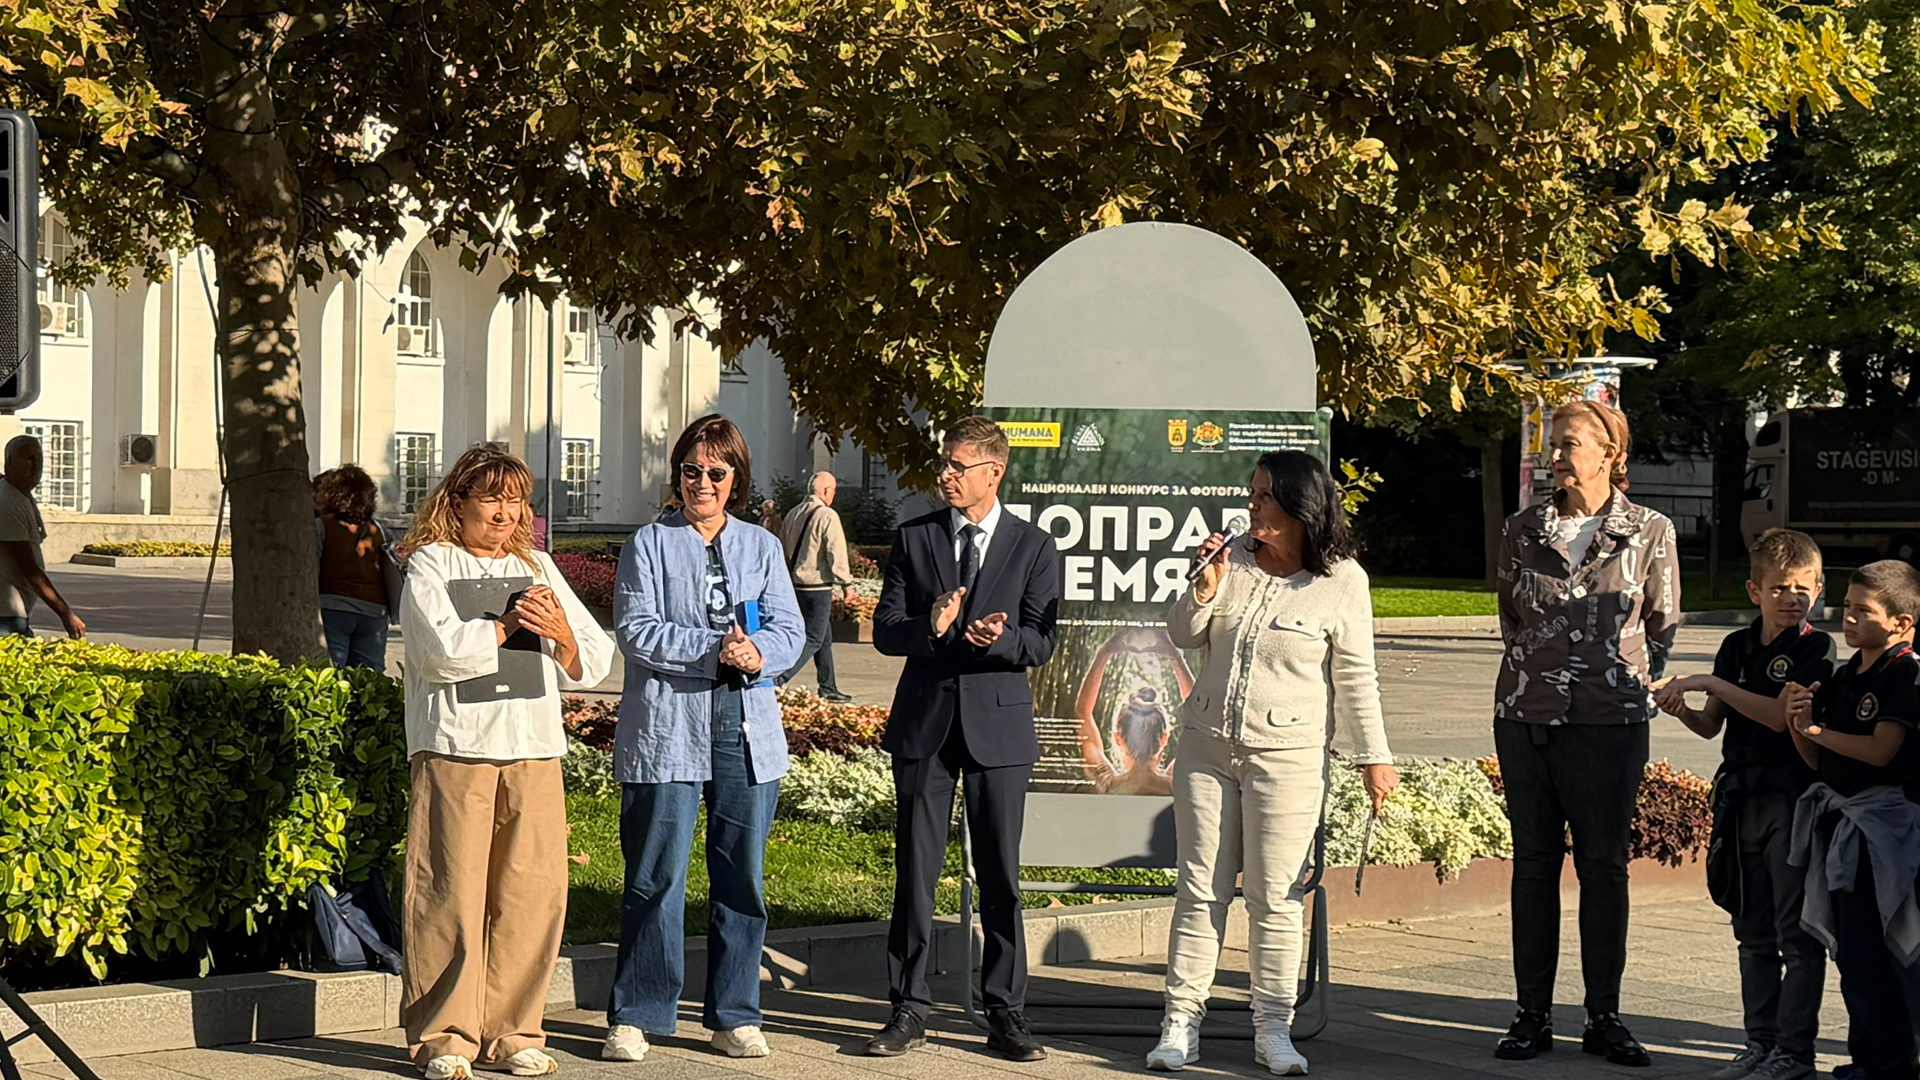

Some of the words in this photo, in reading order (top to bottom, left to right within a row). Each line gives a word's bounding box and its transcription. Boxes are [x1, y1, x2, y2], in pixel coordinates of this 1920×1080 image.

[1002, 427, 1054, 437] HUMANA
[1816, 448, 1920, 469] STAGEVISI
[1022, 483, 1107, 495] НАЦИОНАЛЕН
[1110, 485, 1169, 496] КОНКУРС
[1171, 485, 1188, 496] ЗА
[1190, 486, 1252, 497] ФОТОГРА
[1003, 503, 1251, 553] ОПРА
[1064, 555, 1191, 603] ЕМЯ
